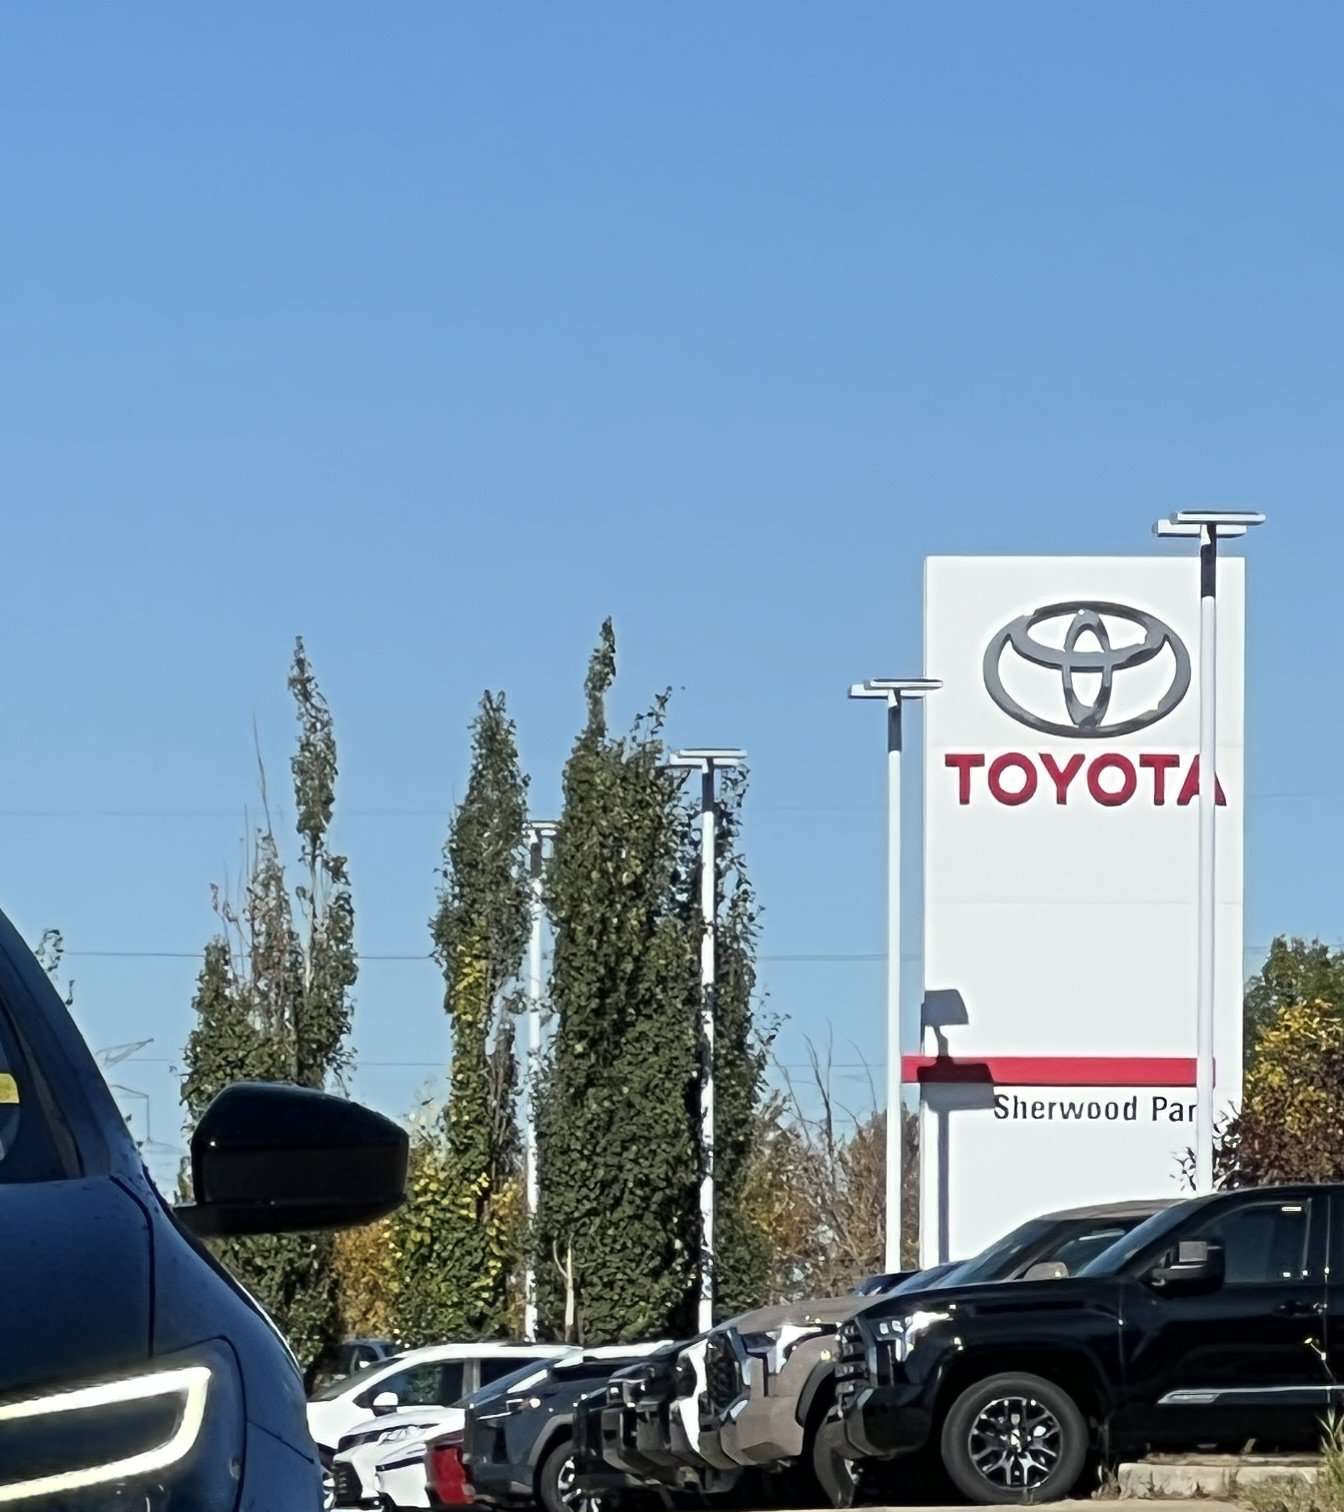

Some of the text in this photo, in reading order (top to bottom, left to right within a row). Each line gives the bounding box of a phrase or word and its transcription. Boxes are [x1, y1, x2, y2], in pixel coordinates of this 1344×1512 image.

[944, 752, 1227, 807] TOYOTA
[993, 1093, 1197, 1122] Sherwood Par
